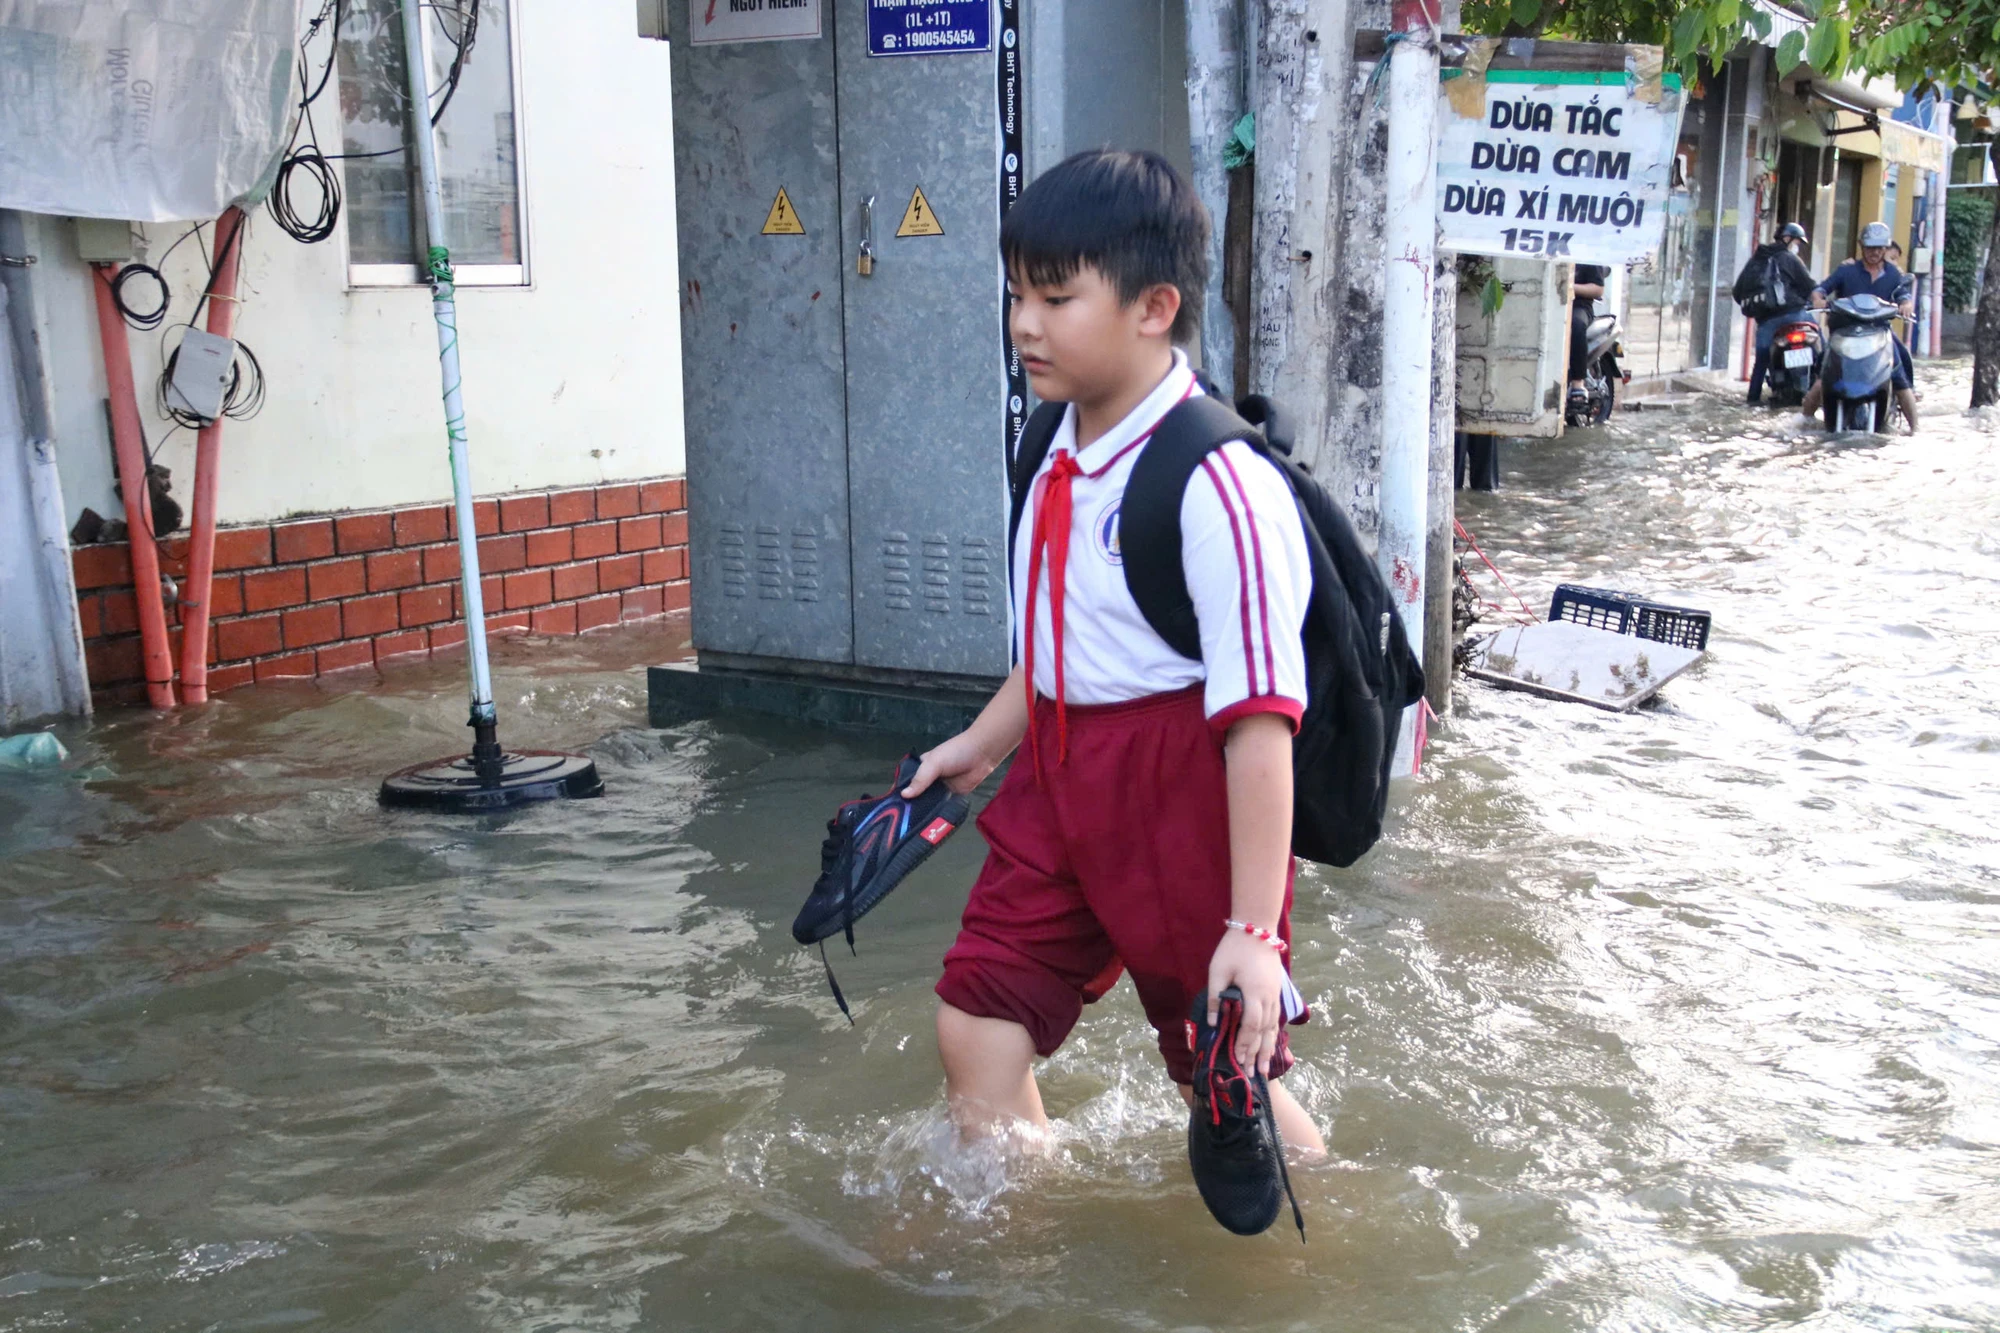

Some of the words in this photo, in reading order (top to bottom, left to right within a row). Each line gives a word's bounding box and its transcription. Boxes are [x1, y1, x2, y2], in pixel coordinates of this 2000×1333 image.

[730, 0, 763, 12] NGUY
[905, 12, 923, 29] (1L
[925, 11, 951, 27] +1T)
[905, 29, 976, 47] 1900545454
[1006, 51, 1015, 74] BHT
[1005, 76, 1015, 135] Technology
[1490, 95, 1553, 133] DỪA
[1565, 94, 1623, 137] TẮC
[1471, 137, 1541, 174] DỪA
[1552, 147, 1632, 181] CAM
[1008, 175, 1017, 198] BHT
[1443, 179, 1506, 217] DỪA
[1515, 184, 1550, 220] XÍ
[1556, 190, 1646, 234] MUỘI
[1500, 227, 1575, 257] 15K
